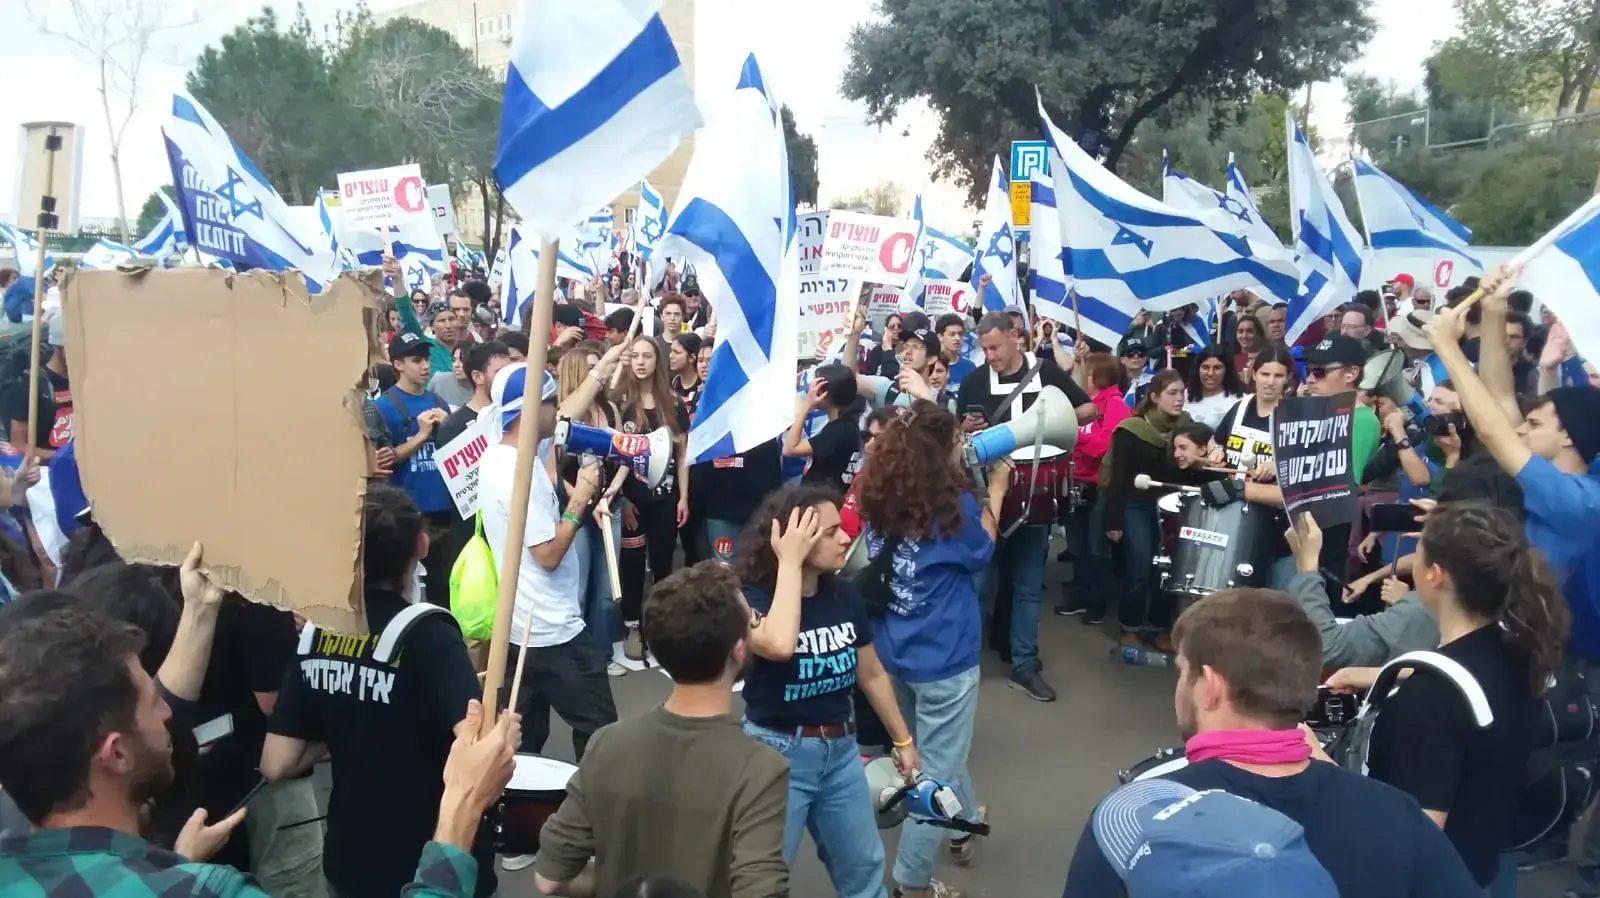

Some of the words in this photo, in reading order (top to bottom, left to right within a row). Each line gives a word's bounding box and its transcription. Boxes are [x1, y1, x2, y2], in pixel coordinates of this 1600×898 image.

[344, 178, 389, 199] עוצרים
[830, 221, 881, 244] עוצרים
[1278, 416, 1334, 448] דמוקרטיה
[1332, 413, 1350, 443] אין
[465, 465, 481, 482] קיקה
[1325, 448, 1347, 477] עם
[455, 478, 480, 501] מוקרטית
[358, 665, 396, 705] אין
